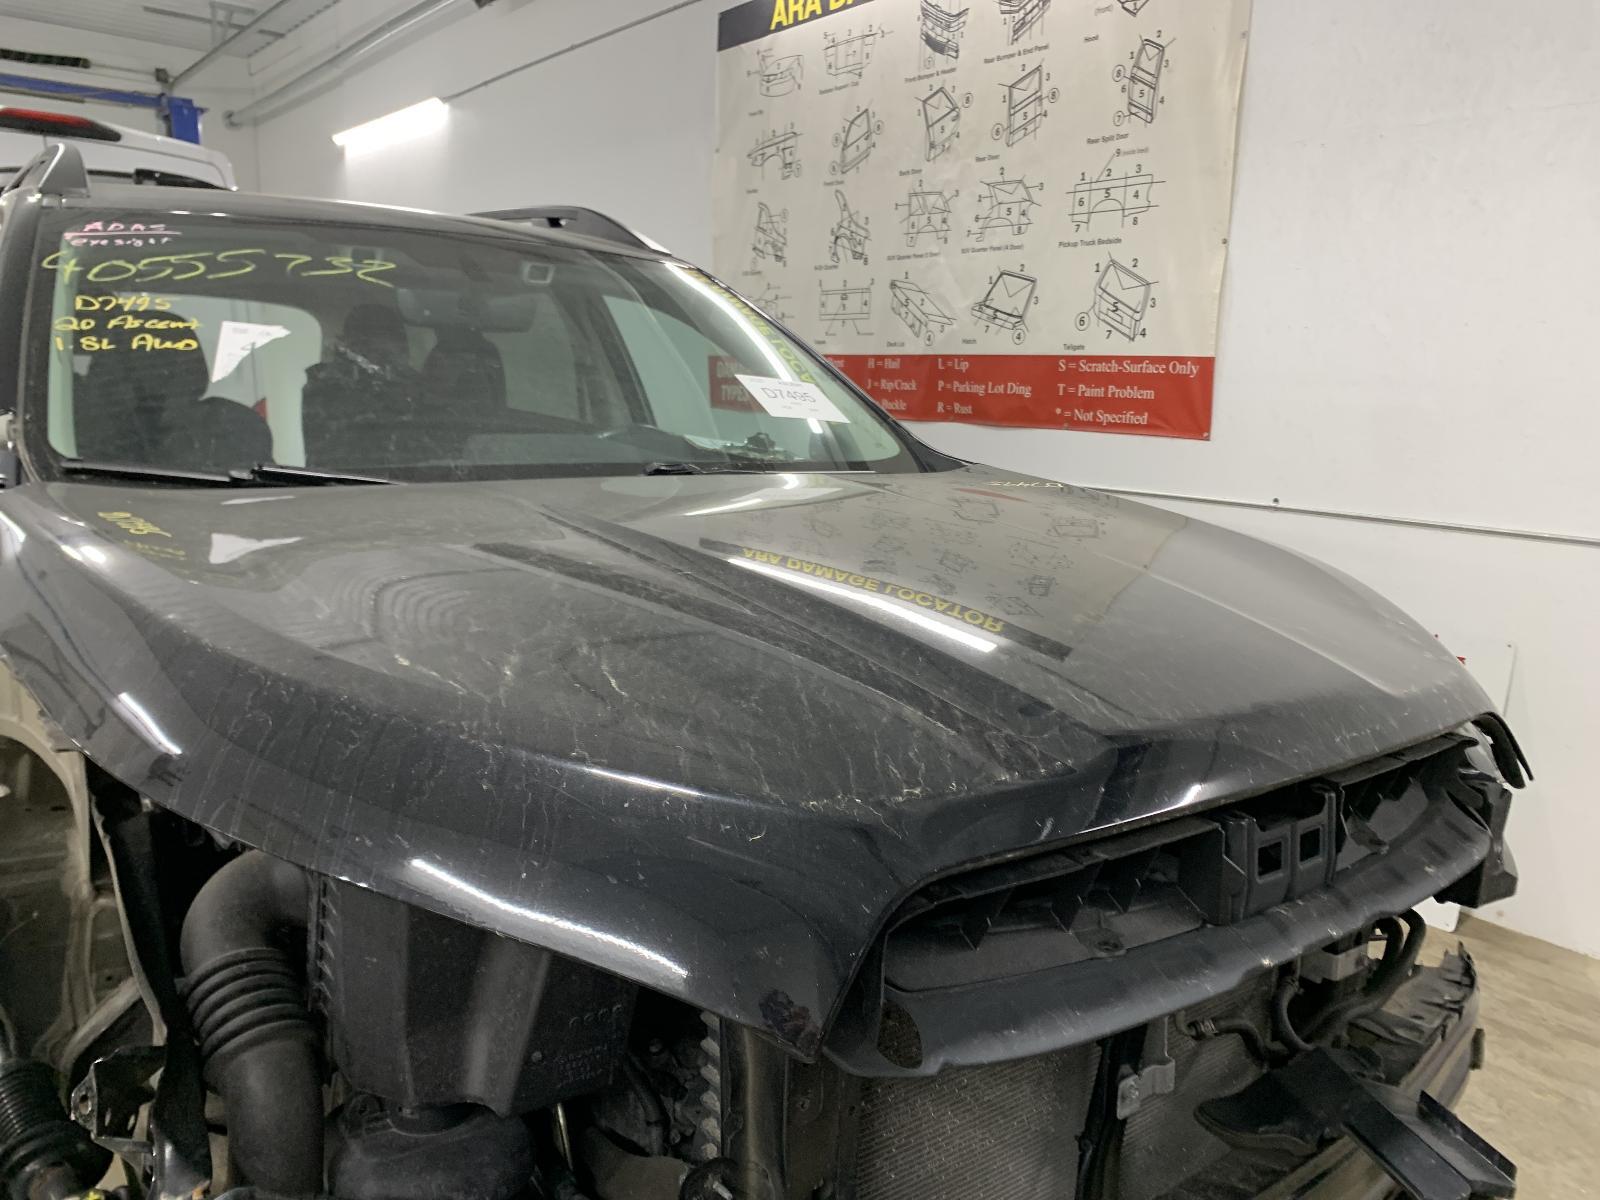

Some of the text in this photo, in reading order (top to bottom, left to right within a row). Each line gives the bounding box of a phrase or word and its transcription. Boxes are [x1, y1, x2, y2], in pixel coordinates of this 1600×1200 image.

[867, 359, 875, 369] H
[884, 358, 900, 369] Hail
[938, 358, 945, 370] L
[954, 358, 969, 373] Lip
[1058, 359, 1067, 372] S
[1078, 359, 1167, 374] Scratch-Surface
[1169, 360, 1200, 378] Only
[938, 380, 945, 392] P
[952, 381, 985, 397] Parking
[988, 382, 1005, 394] Lot
[1007, 383, 1032, 398] Ding
[1057, 383, 1066, 396] T
[1077, 384, 1105, 398] Paint
[1108, 385, 1155, 400] Problem
[937, 401, 944, 413] R
[953, 402, 973, 415] Rust
[1074, 408, 1094, 421] Not
[1096, 409, 1149, 426] Specified
